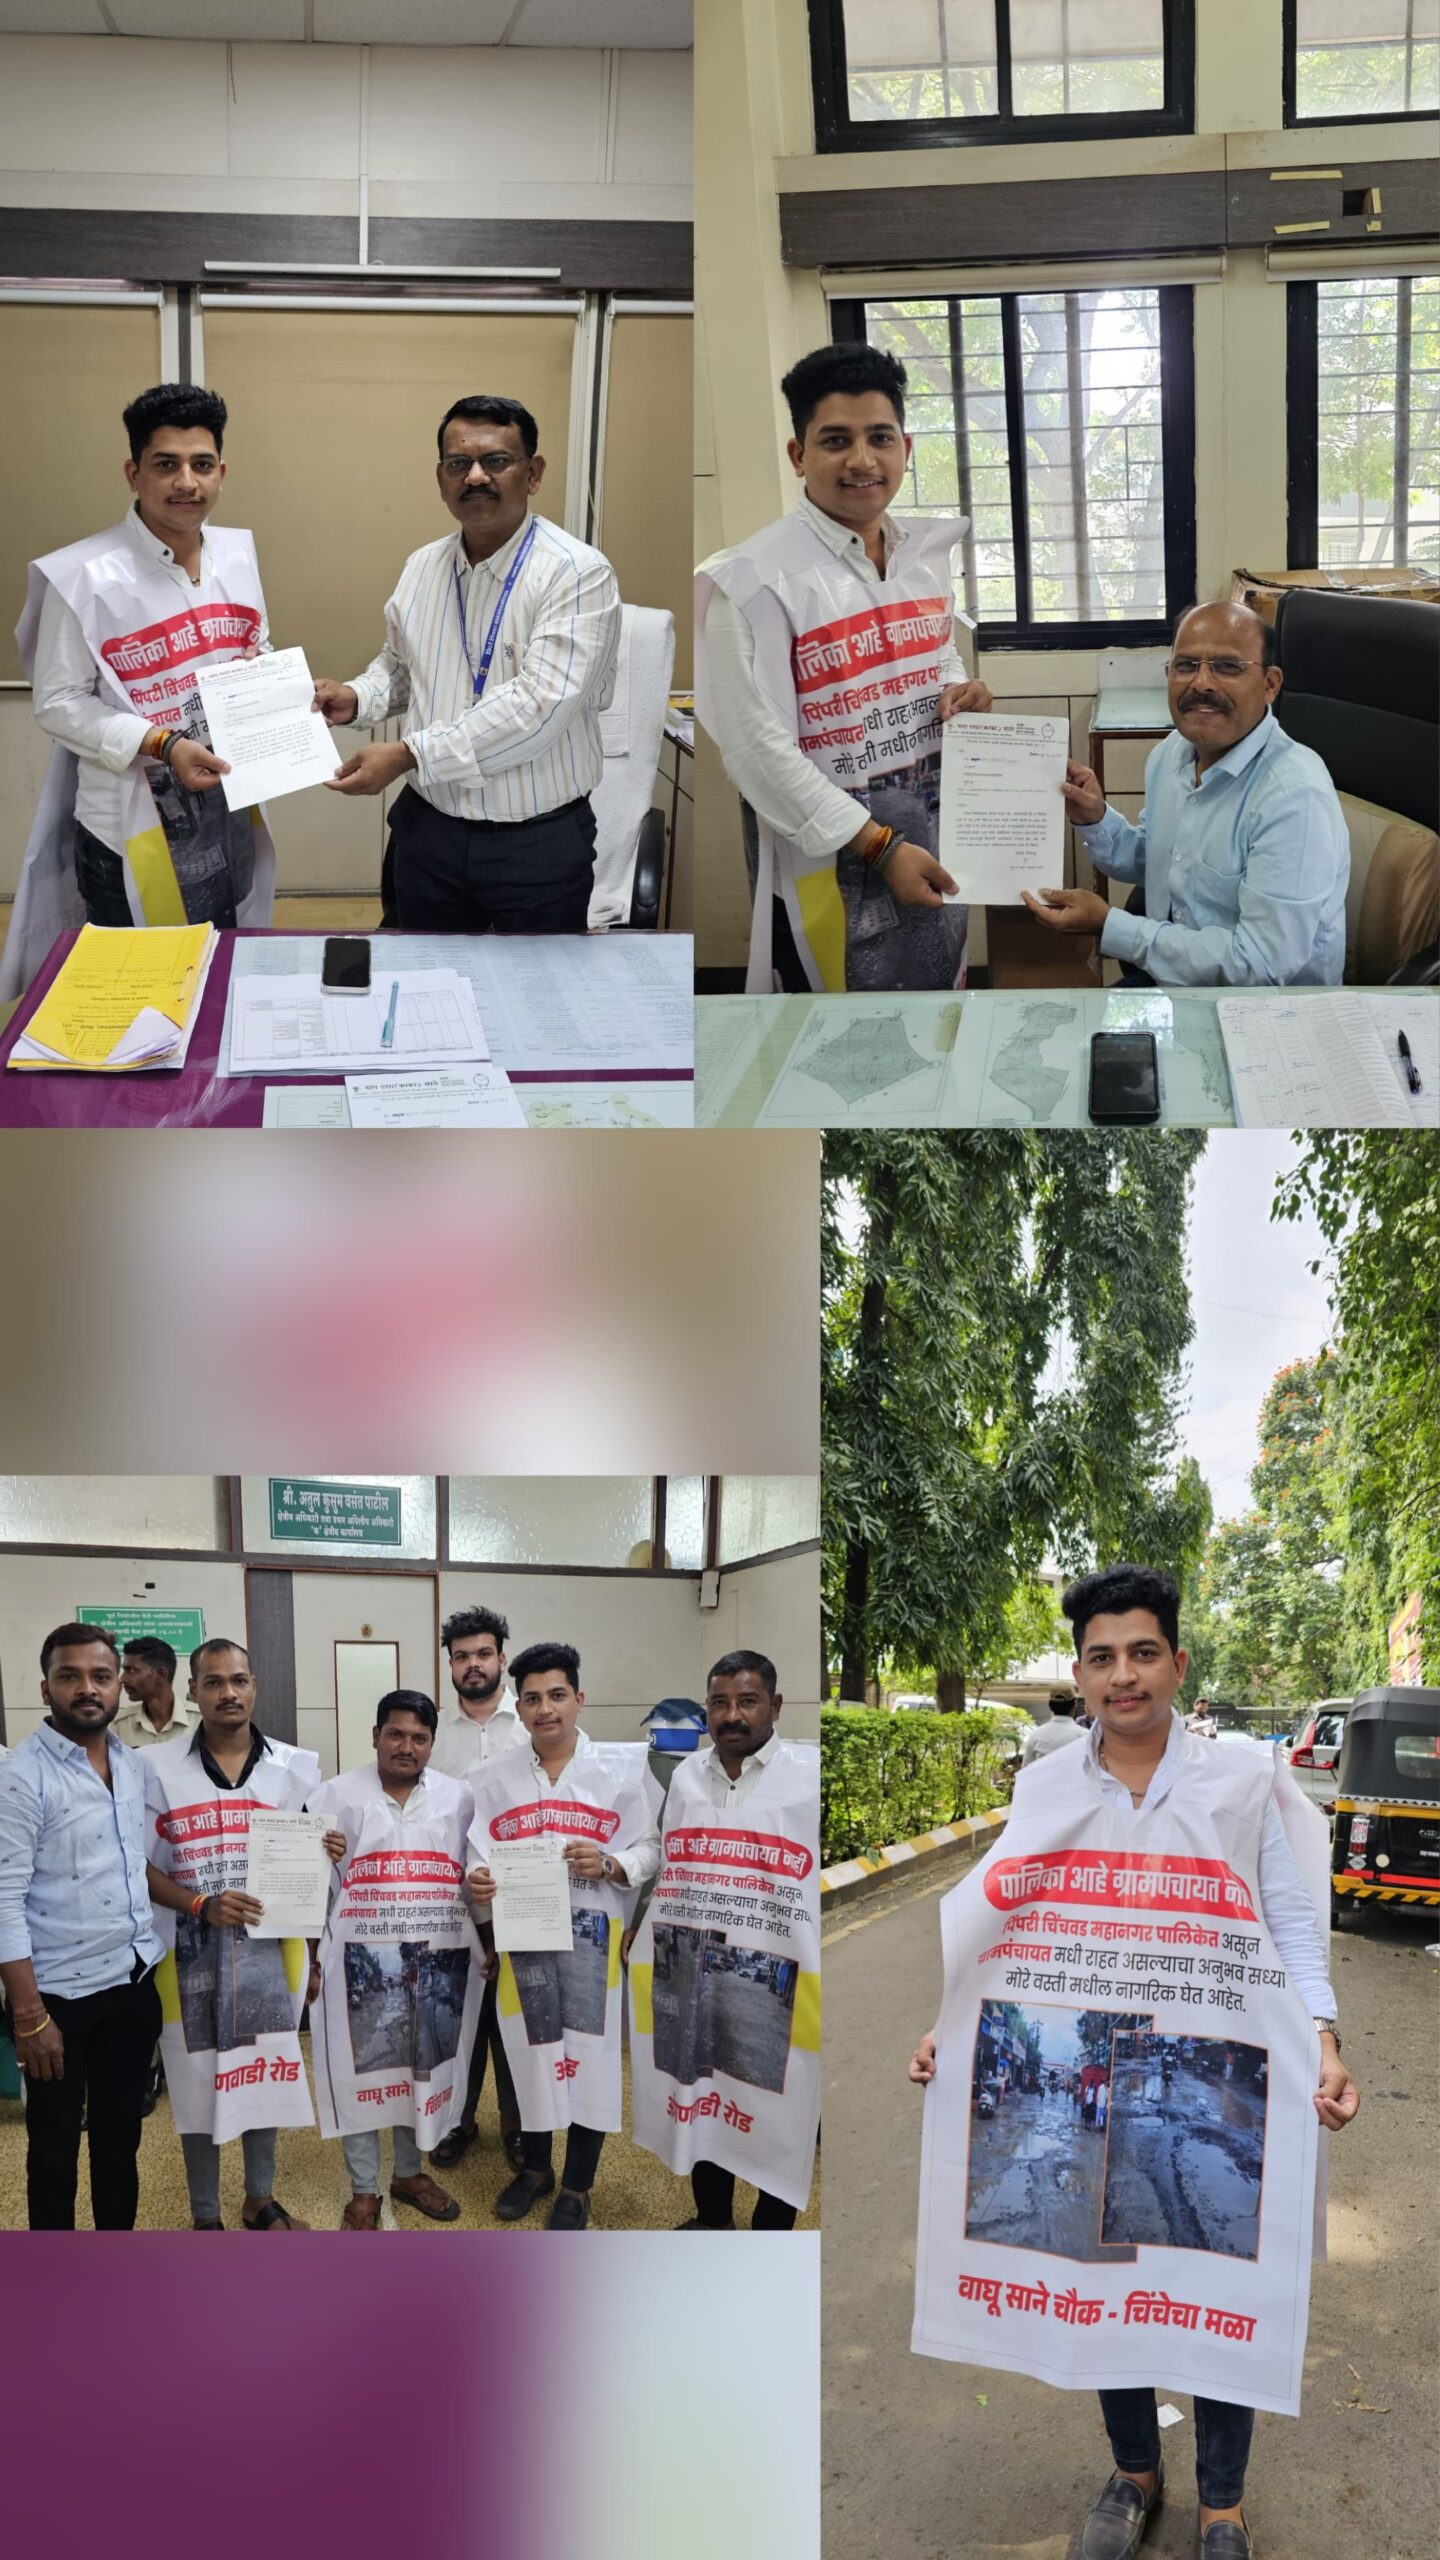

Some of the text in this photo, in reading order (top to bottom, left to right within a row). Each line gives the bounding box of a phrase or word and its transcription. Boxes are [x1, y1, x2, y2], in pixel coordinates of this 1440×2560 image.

[107, 639, 170, 672] पालिका
[170, 620, 200, 652] आहे
[852, 620, 884, 657] आहे
[802, 692, 843, 724] पिंपरी
[283, 1484, 389, 1514] श्री. अतुल कुसुम वसंत पाटील
[295, 1511, 319, 1523] अधिकारी
[192, 1808, 219, 1830] आहे
[708, 1836, 781, 1866] ग्रामपंचायत
[383, 1857, 406, 1877] आहे
[733, 1874, 775, 1895] पालिकेत
[998, 1862, 1065, 1900] पालिका
[1070, 1861, 1107, 1894] आहे
[1112, 1865, 1221, 1904] ग्रामपंचायत
[379, 1905, 395, 1918] मधी
[704, 1908, 745, 1927] नागरिक
[746, 1914, 763, 1930] घेत
[709, 1891, 758, 1909] असल्याचा
[760, 1900, 795, 1919] अनुभव
[370, 1922, 389, 1935] वस्ती
[1042, 1912, 1088, 1937] चिंचवड
[1090, 1920, 1153, 1941] महानगर
[1156, 1920, 1219, 1949] पालिकेत
[1222, 1932, 1261, 1960] असून
[1054, 1943, 1082, 1966] मधी
[1085, 1949, 1119, 1969] राहत
[1122, 1951, 1194, 1974] असल्याचा
[1198, 1957, 1246, 1985] अनुभव
[1248, 1966, 1286, 1989] सध्या
[1005, 1966, 1247, 2014] मोरे वस्ती मधील नागरिक घेत आहेत.
[270, 2056, 300, 2081] रोड
[357, 2088, 384, 2105] वाघू
[385, 2080, 410, 2098] साने
[723, 2100, 755, 2134] रोड
[958, 2274, 1257, 2342] वाघू साने चौक - चिंचेचा मळा
